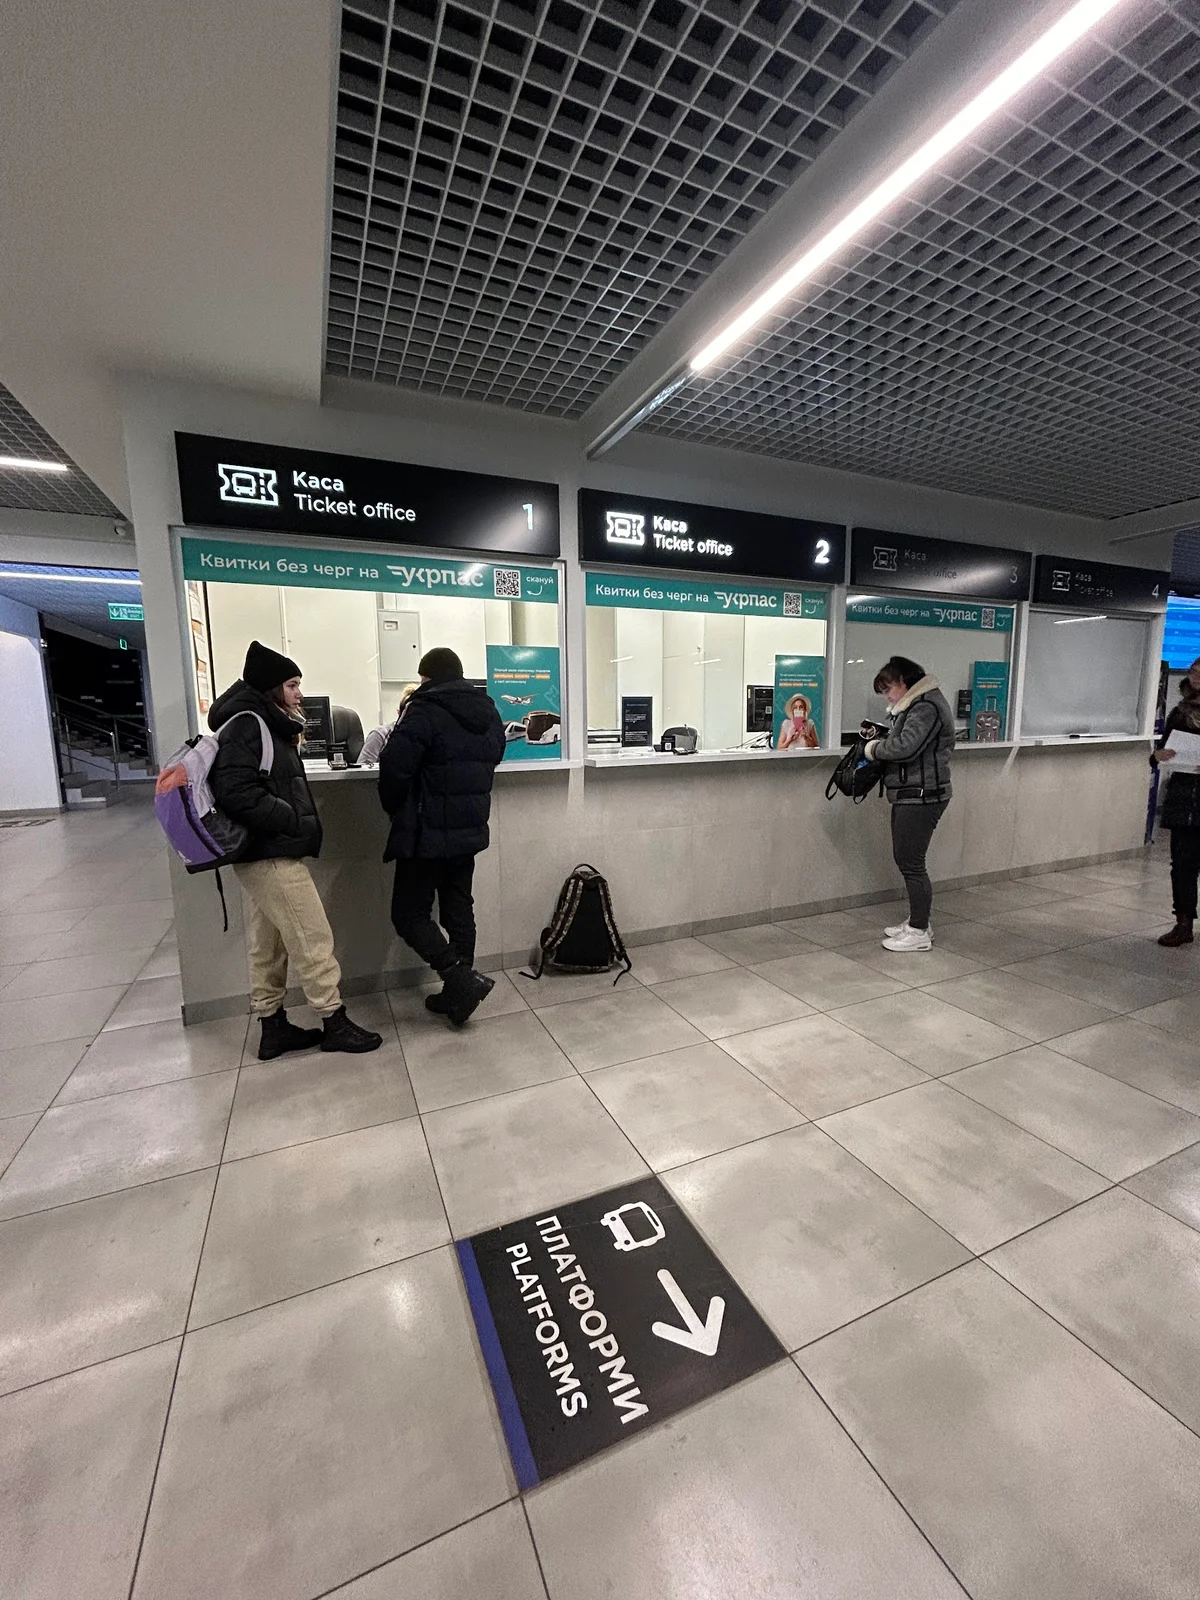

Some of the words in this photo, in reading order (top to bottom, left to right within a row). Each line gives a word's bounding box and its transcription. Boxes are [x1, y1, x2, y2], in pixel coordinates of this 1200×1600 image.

[293, 469, 345, 492] Каса
[293, 493, 356, 516] Ticket
[363, 502, 417, 522] office
[522, 503, 535, 531] 1
[653, 515, 688, 534] Каса
[653, 533, 695, 553] Ticket
[696, 539, 733, 557] office
[814, 539, 830, 564] 2
[904, 549, 927, 561] Каса
[200, 552, 271, 572] Квитки
[276, 557, 308, 574] без
[313, 563, 354, 580] черг
[359, 566, 379, 580] на
[1009, 565, 1019, 584] 3
[526, 574, 554, 586] скануй
[1151, 584, 1160, 599] 4
[595, 584, 640, 599] Квитки
[643, 586, 664, 600] без
[666, 592, 692, 605] черг
[696, 593, 709, 603] на
[851, 603, 883, 614] Квитки
[884, 605, 899, 616] без
[900, 608, 919, 618] черг
[920, 609, 930, 618] на
[505, 1242, 588, 1418] PLATFORMS
[535, 1215, 650, 1425] ПЛАТФОРМИ
